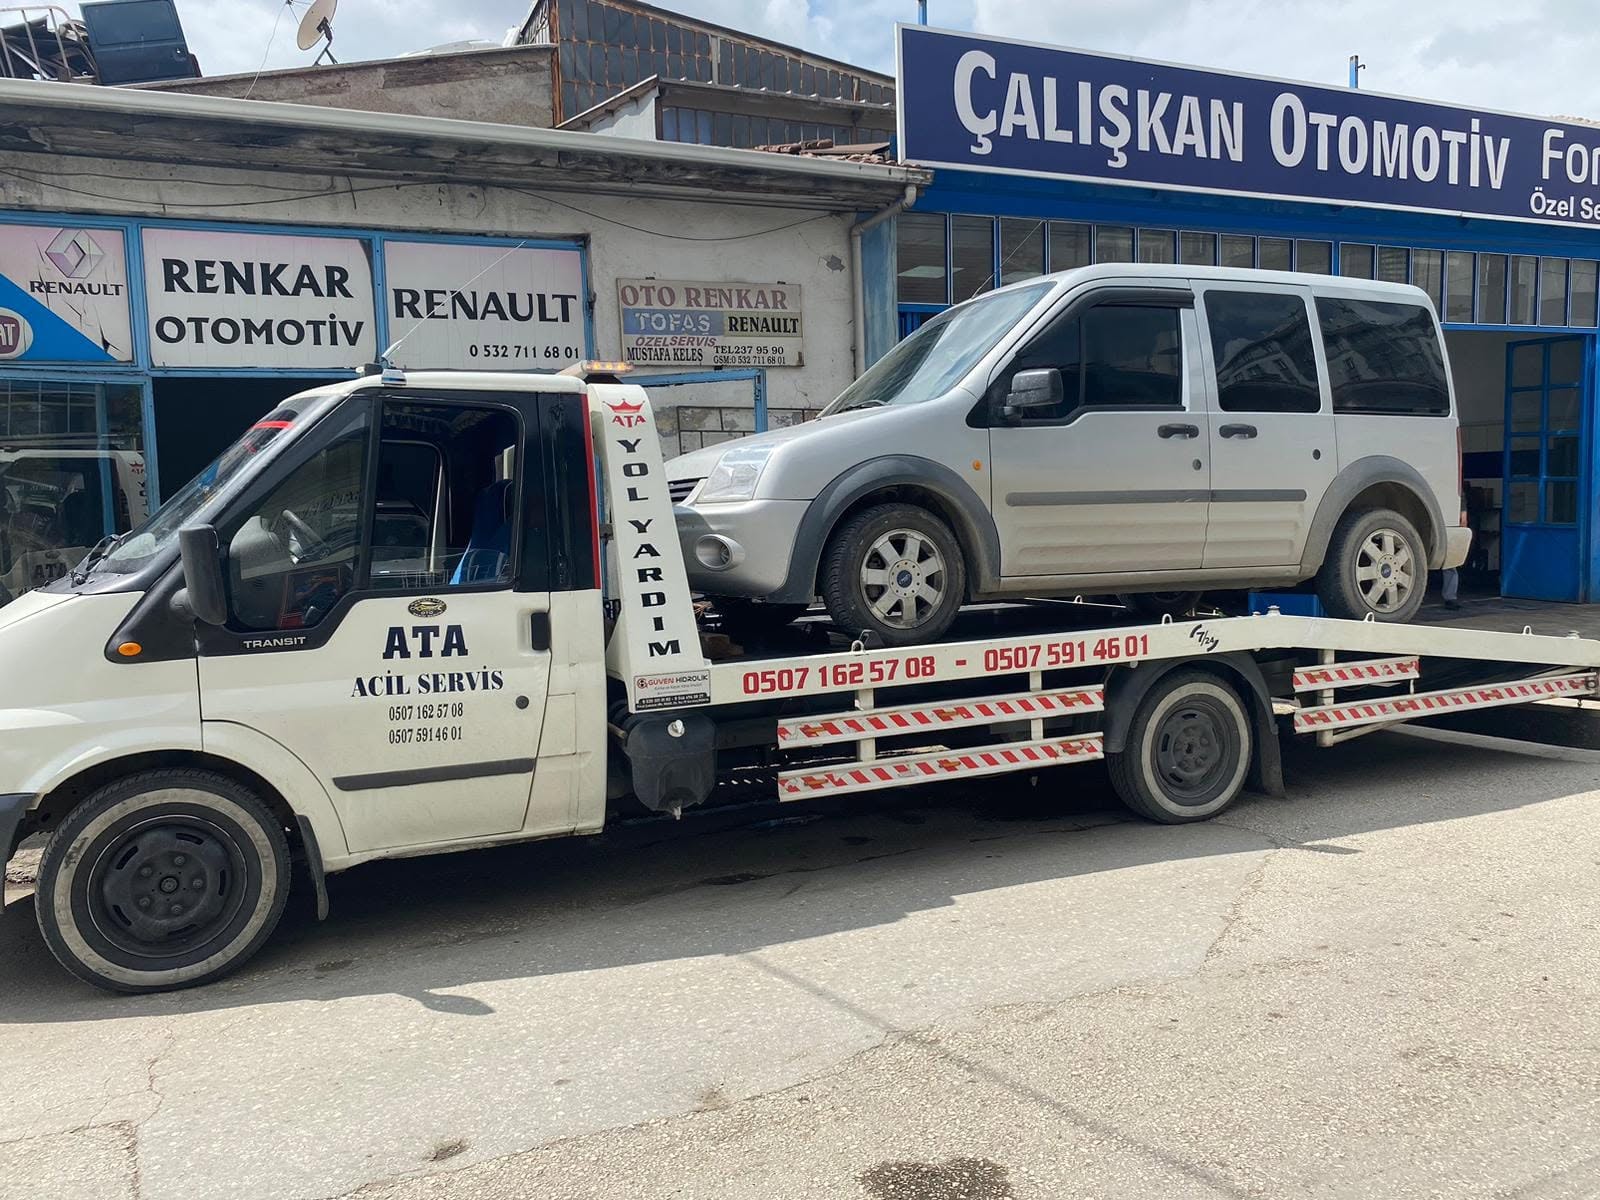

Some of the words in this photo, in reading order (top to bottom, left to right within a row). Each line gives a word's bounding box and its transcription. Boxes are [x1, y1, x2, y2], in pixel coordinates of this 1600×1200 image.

[953, 50, 1243, 168] ÇALIŞKAN
[1270, 92, 1510, 190] OTOMOTİV
[1530, 186, 1575, 217] Özel
[162, 258, 354, 299] RENKAR
[30, 280, 124, 296] RENAULT
[392, 288, 577, 323] RENAULT
[621, 285, 676, 307] OTO
[685, 287, 788, 310] RENKAR
[155, 313, 364, 347] OTOMOTİV
[728, 316, 799, 334] RENAULT
[469, 344, 478, 357] 0
[483, 344, 508, 358] 532
[514, 345, 537, 358] 711
[544, 346, 560, 359] 68
[564, 346, 579, 359] 01
[627, 346, 671, 361] MUSTAFA
[756, 346, 769, 354] 95
[771, 346, 784, 354] 90
[738, 356, 751, 364] 532
[752, 356, 765, 364] 711
[767, 356, 776, 364] 68
[778, 356, 786, 364] 01
[612, 415, 646, 428] ATA
[243, 636, 306, 648] TRANSIT
[383, 624, 468, 660] ATA
[743, 667, 809, 694] 0507
[818, 662, 864, 688] 162
[870, 659, 899, 682] 57
[905, 656, 936, 678] 08
[984, 645, 1042, 672] 0507
[1047, 641, 1086, 666] 591
[1093, 637, 1120, 660] 46
[1125, 634, 1149, 657] 01
[351, 670, 411, 697] ACİL
[418, 666, 504, 694] SERVİS
[389, 705, 413, 720] 0507
[417, 704, 434, 719] 162
[436, 704, 448, 718] 57
[452, 702, 464, 718] 08
[389, 728, 413, 744] 0507
[416, 727, 432, 742] 591
[436, 726, 448, 741] 46
[451, 726, 462, 740] 01
